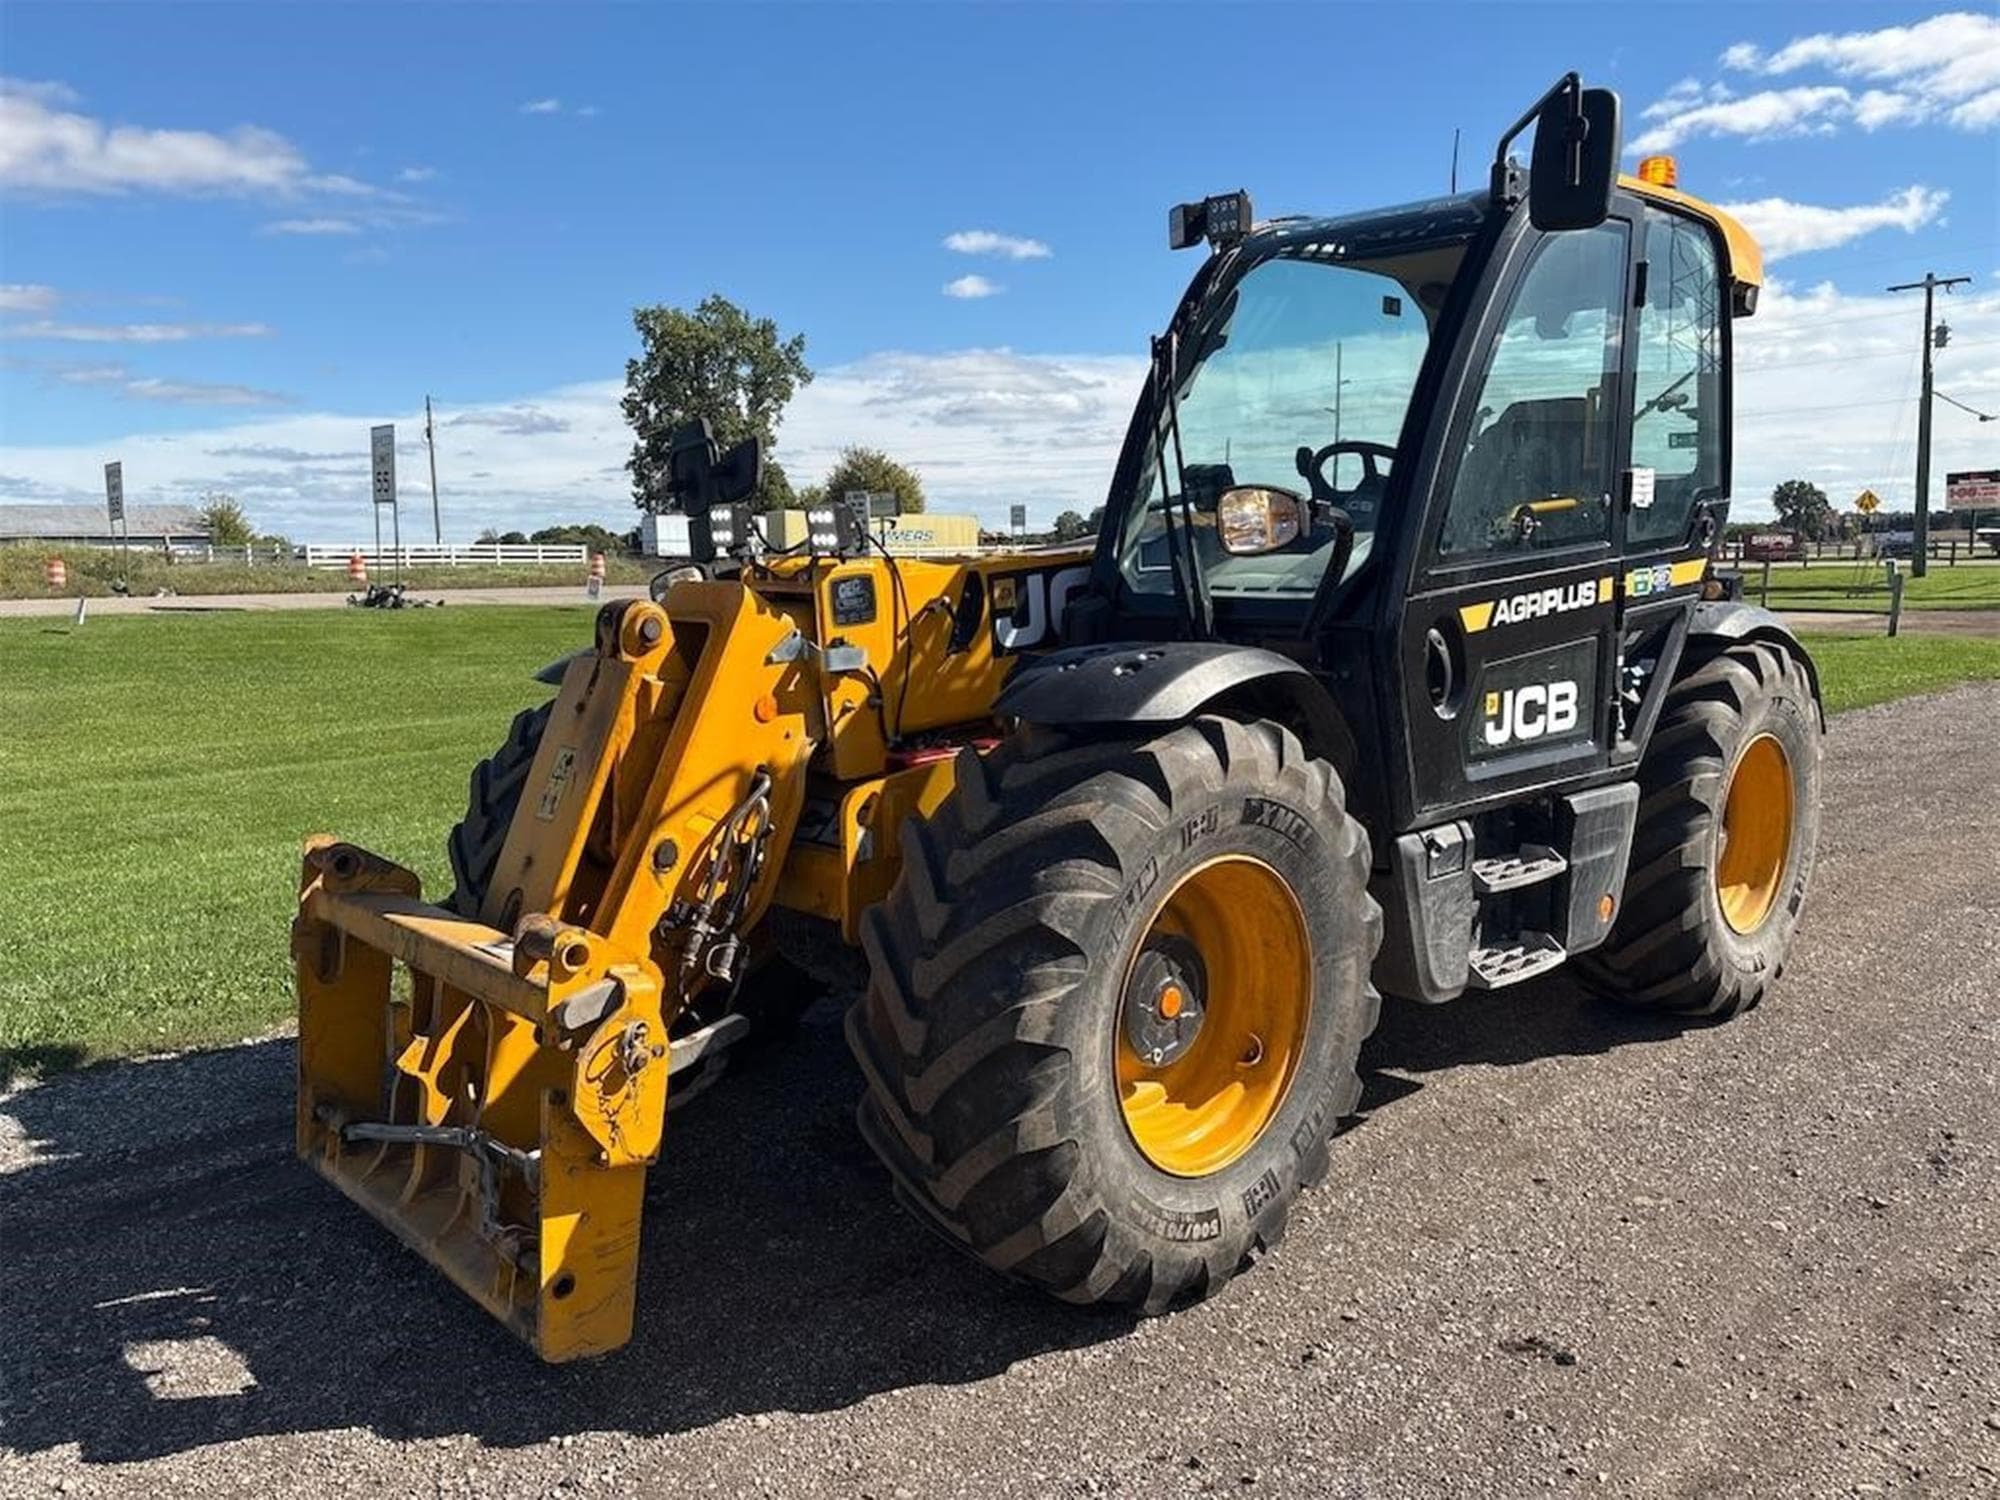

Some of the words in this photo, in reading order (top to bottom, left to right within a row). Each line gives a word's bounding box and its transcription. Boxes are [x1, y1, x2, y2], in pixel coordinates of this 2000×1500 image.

[376, 471, 390, 492] 55
[996, 566, 1092, 648] JC
[1492, 580, 1597, 627] AGRIPLUS
[1485, 680, 1578, 745] JCB
